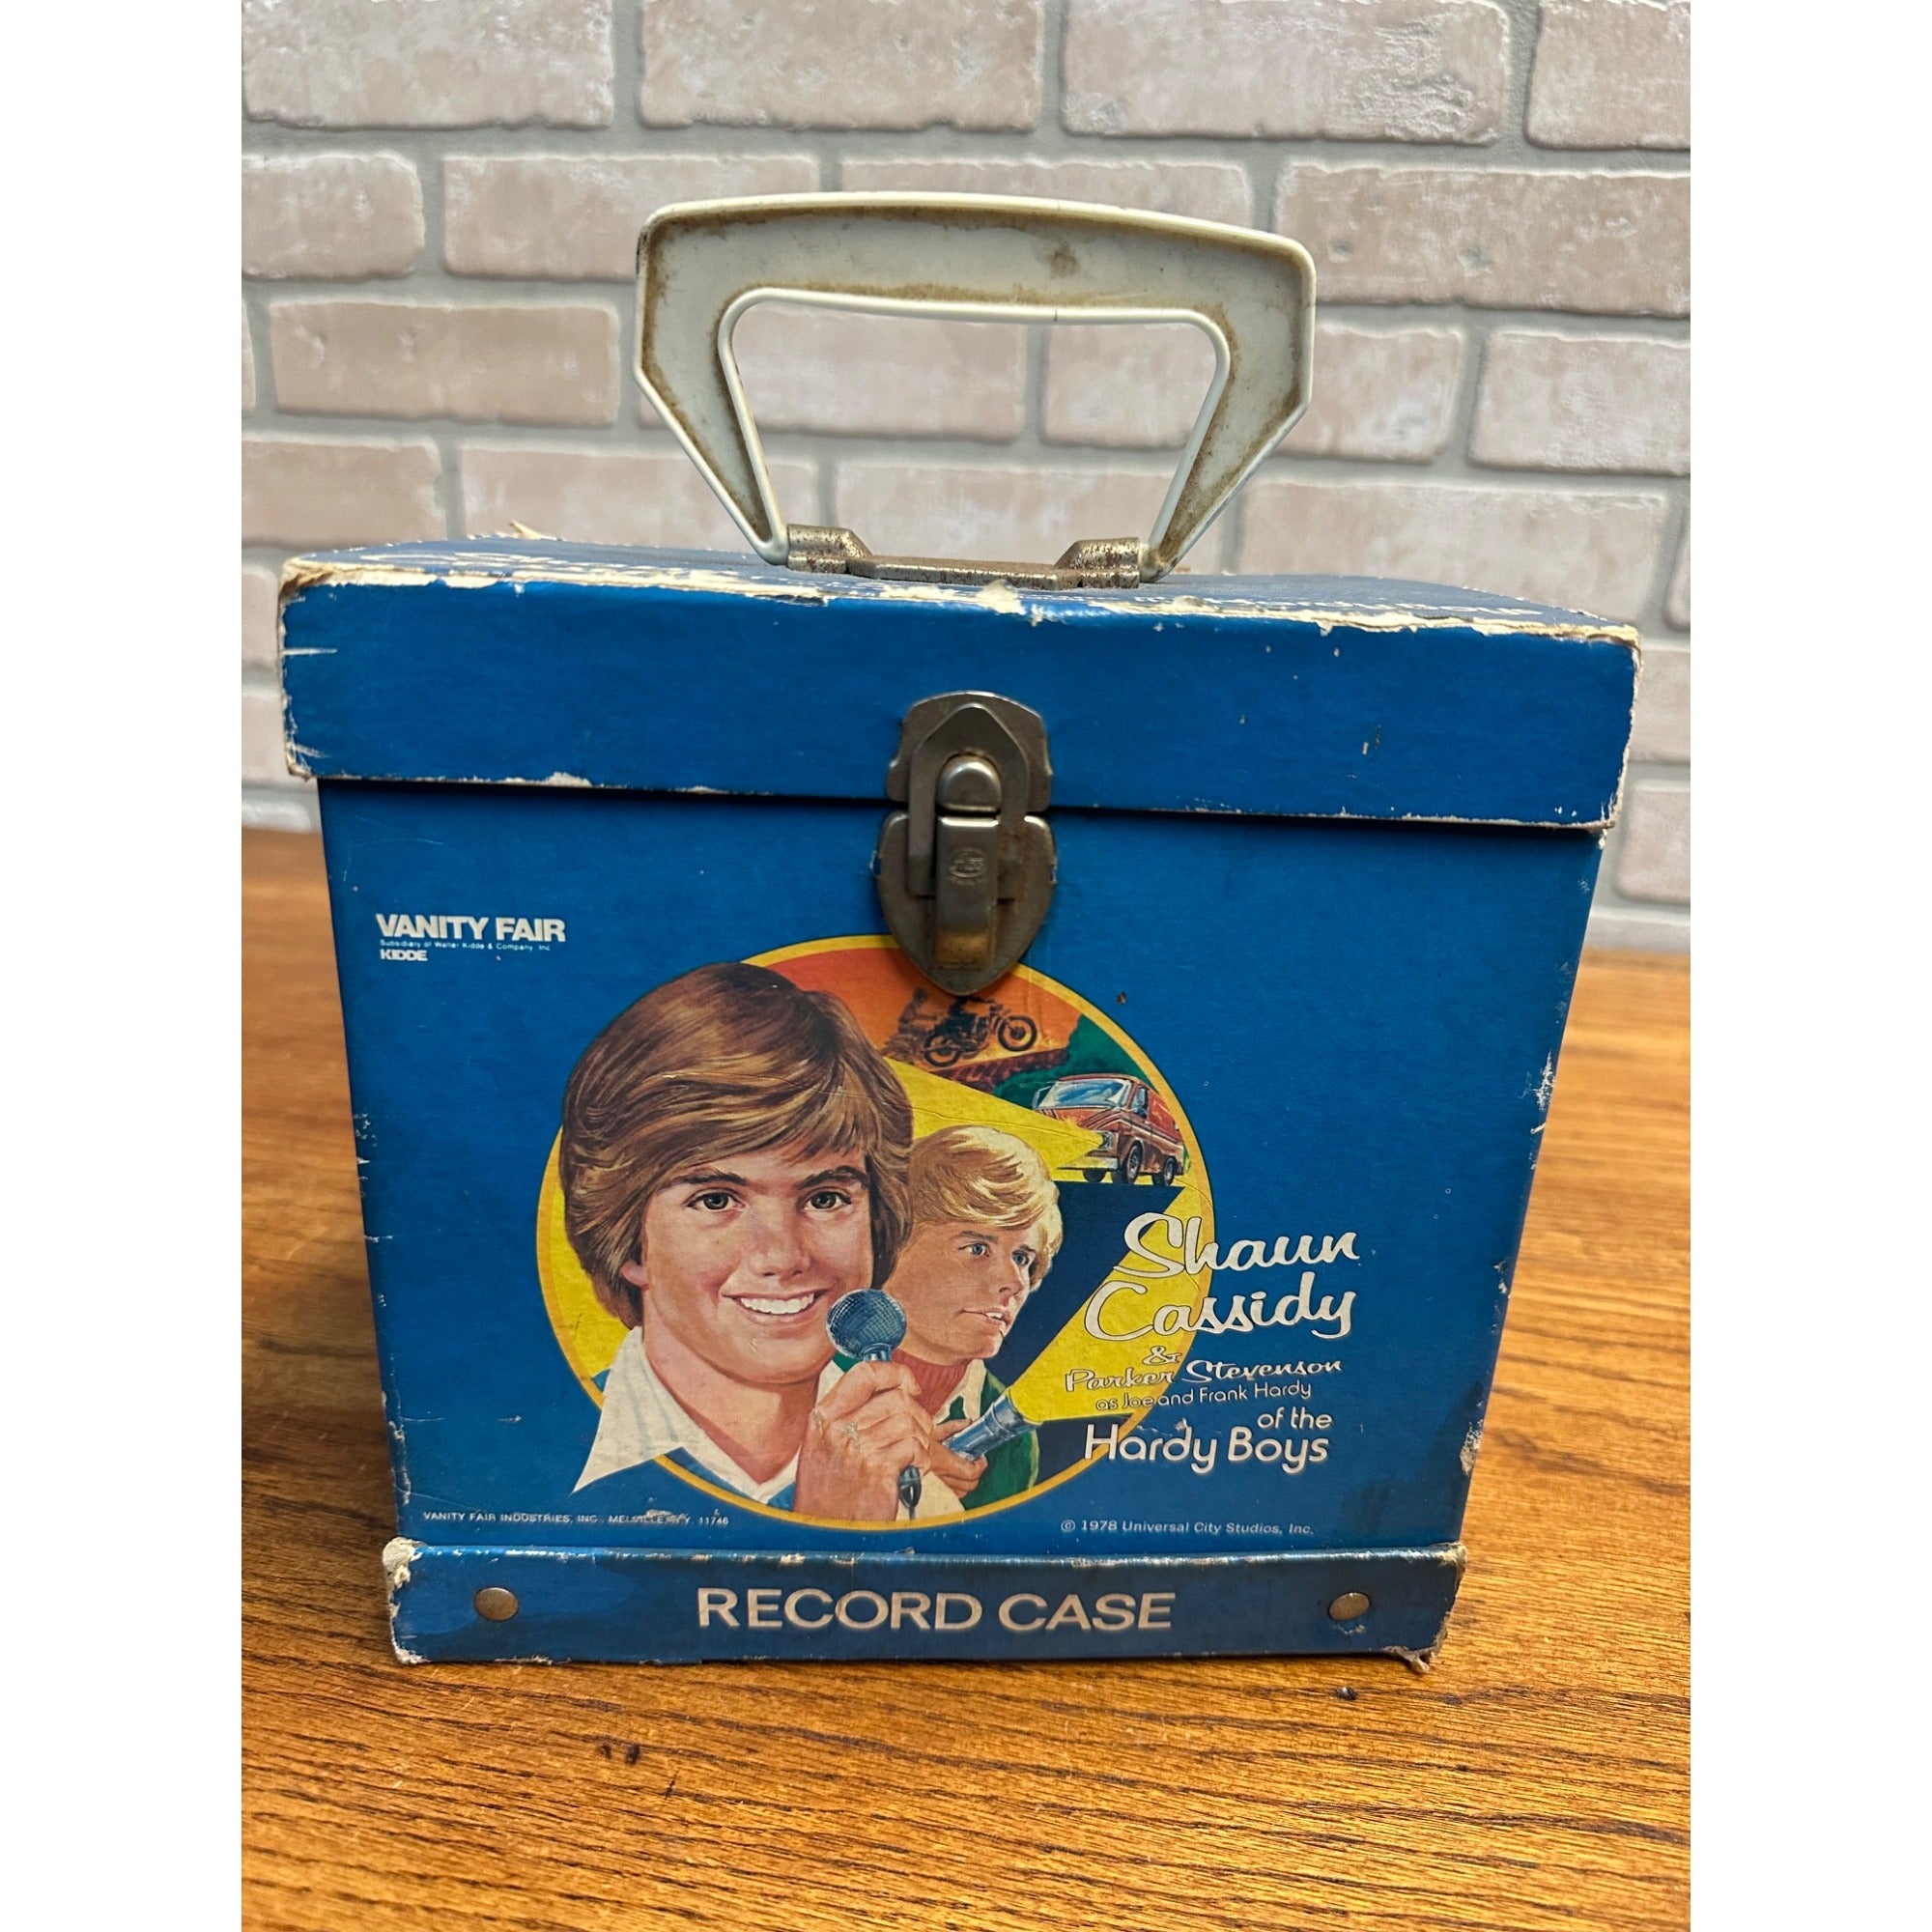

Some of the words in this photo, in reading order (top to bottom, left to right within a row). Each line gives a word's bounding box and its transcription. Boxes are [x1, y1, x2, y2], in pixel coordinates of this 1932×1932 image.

[376, 914, 489, 940] VANITY
[496, 917, 566, 942] FAIR
[380, 949, 428, 961] KIDDE
[1113, 1212, 1360, 1279] Shaun
[1084, 1271, 1357, 1342] Cassidy
[1142, 1345, 1182, 1366] &
[1065, 1367, 1176, 1392] Parker
[1181, 1359, 1343, 1383] Stevenson
[1095, 1399, 1118, 1411] as
[1122, 1393, 1154, 1408] Joe
[1157, 1389, 1194, 1406] and
[1199, 1385, 1248, 1403] Frank
[1254, 1379, 1312, 1399] Hardy
[1257, 1407, 1284, 1430] of
[1290, 1406, 1333, 1430] the
[1084, 1423, 1218, 1474] Hardy
[1227, 1425, 1329, 1474] Boys
[423, 1512, 466, 1520] VANITY
[469, 1513, 496, 1521] FAIR
[1081, 1520, 1117, 1531] 1978
[1122, 1520, 1189, 1532] Universal
[1193, 1521, 1221, 1534] City
[1289, 1523, 1314, 1535] Inc.
[697, 1587, 982, 1630] RECORD
[998, 1592, 1175, 1630] CASE
